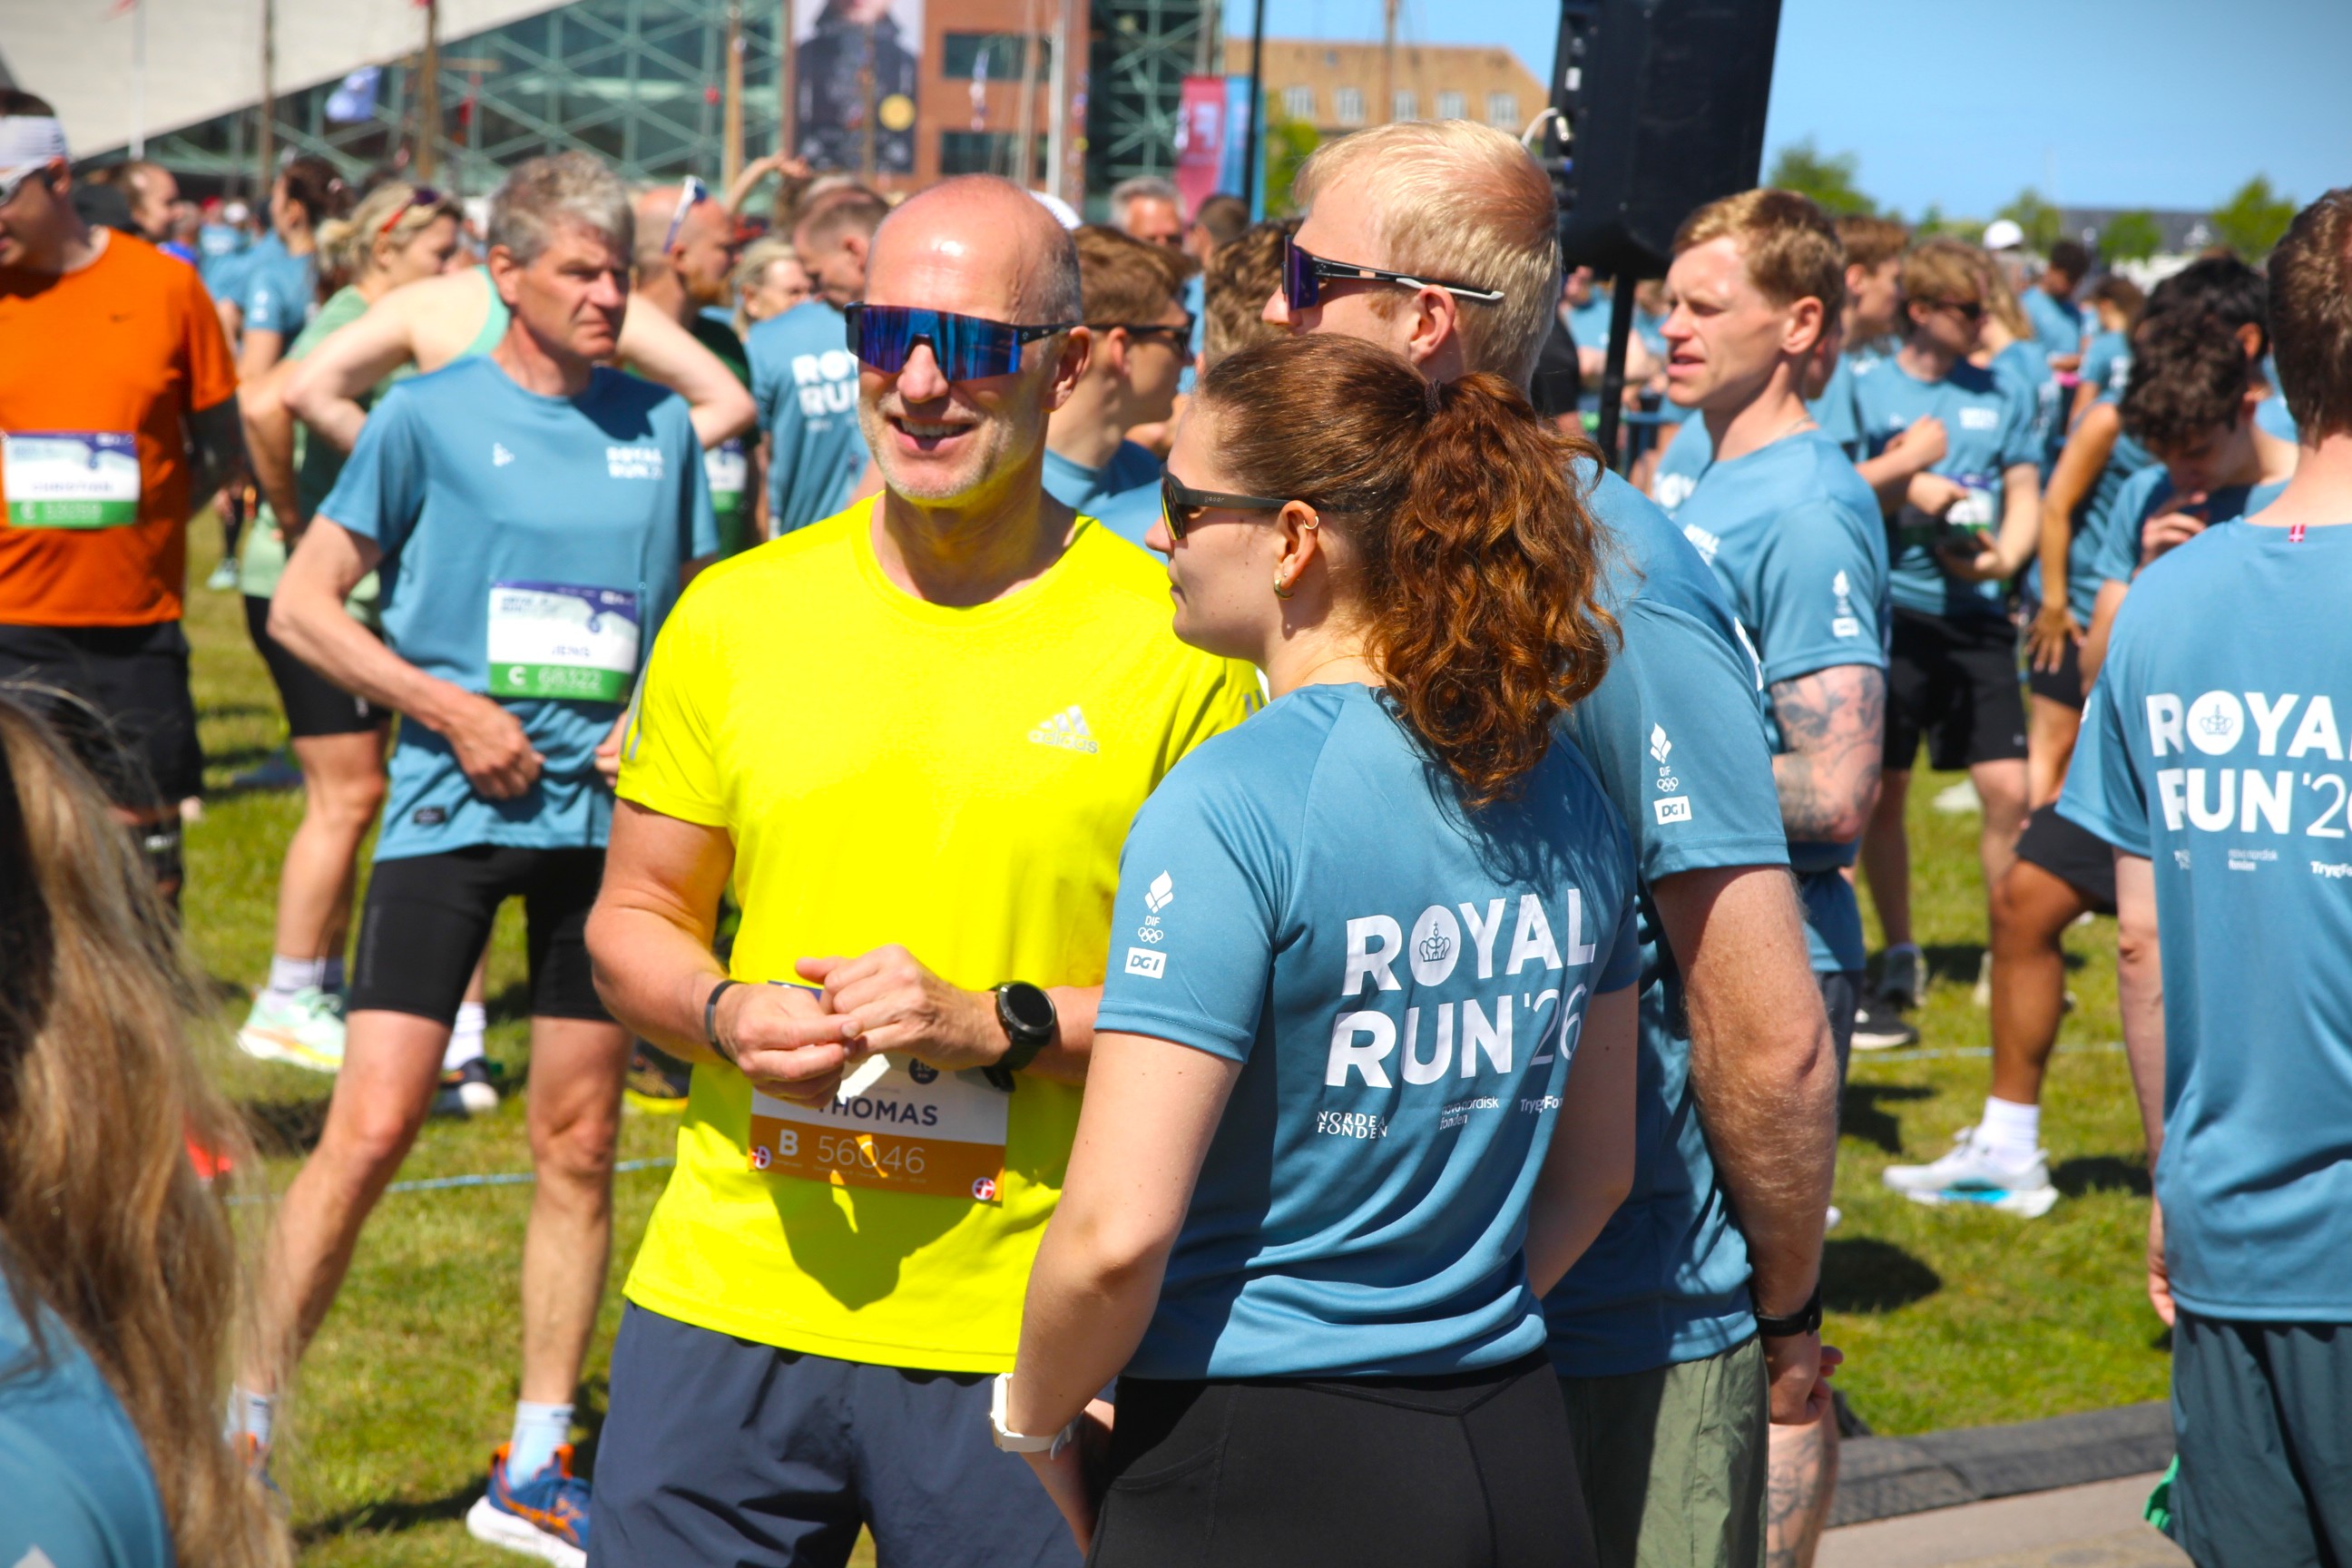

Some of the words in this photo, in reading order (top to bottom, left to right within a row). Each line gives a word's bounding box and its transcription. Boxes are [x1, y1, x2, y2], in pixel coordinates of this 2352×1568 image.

[791, 350, 859, 386] RO
[508, 665, 527, 686] C
[2146, 690, 2352, 761] ROYA
[1028, 730, 1098, 754] adidas
[1662, 803, 1684, 818] DGI
[1145, 916, 1161, 926] DIF
[1342, 888, 1595, 996] ROYAL
[1130, 955, 1160, 971] DGI
[1324, 995, 1513, 1089] RUN
[818, 1095, 938, 1126] HOMAS
[1461, 1095, 1499, 1112] nordisk
[1318, 1122, 1388, 1140] FONDEN
[1439, 1113, 1468, 1131] fonden
[779, 1128, 799, 1157] B
[817, 1135, 926, 1174] 56046
